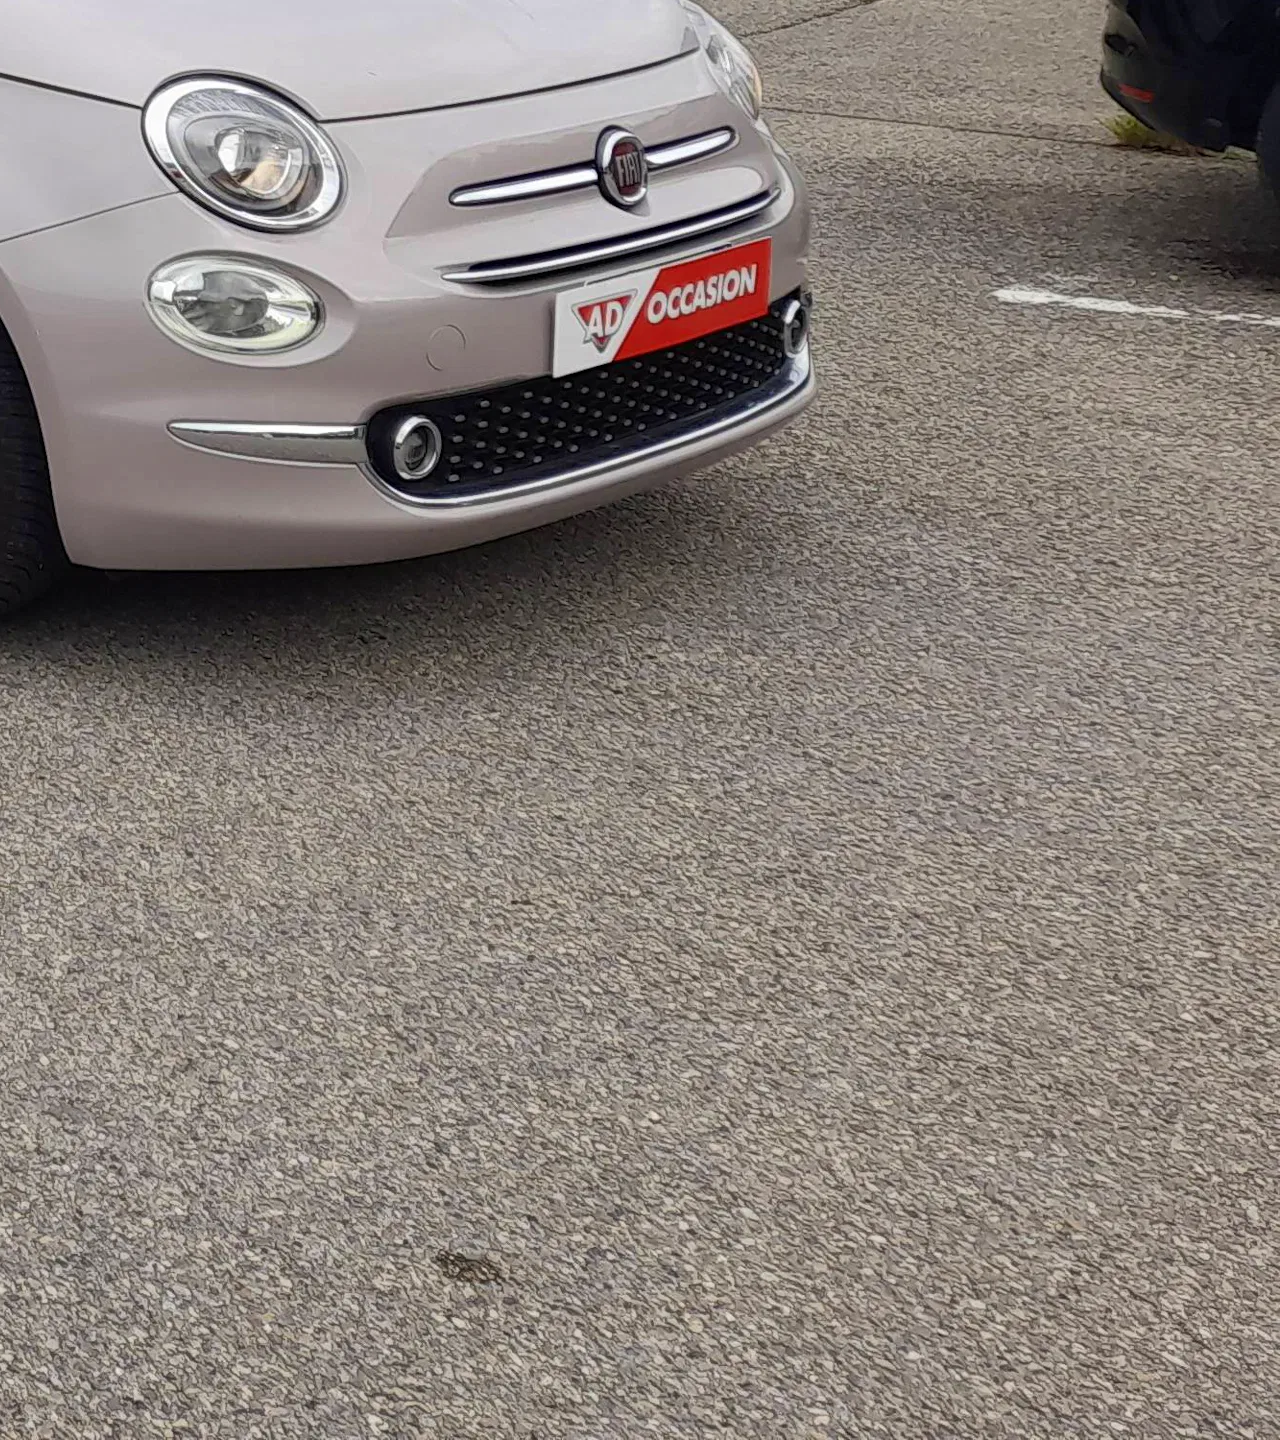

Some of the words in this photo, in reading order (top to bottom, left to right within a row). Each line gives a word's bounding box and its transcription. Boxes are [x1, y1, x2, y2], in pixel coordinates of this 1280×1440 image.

[615, 151, 642, 188] FIAT
[586, 300, 625, 339] AD
[647, 263, 758, 325] OCCASION
